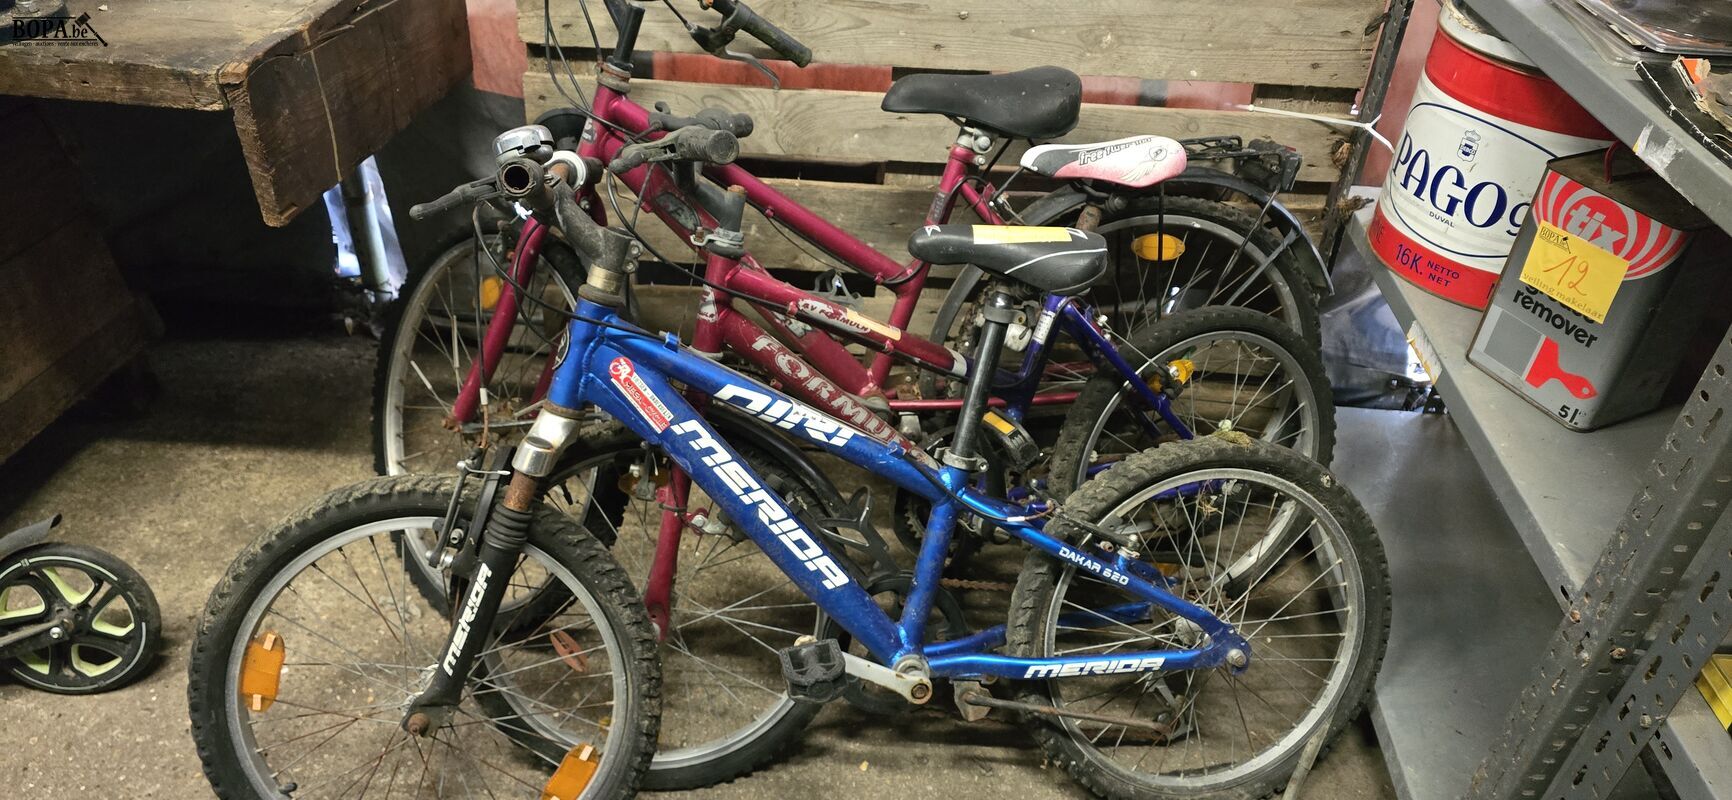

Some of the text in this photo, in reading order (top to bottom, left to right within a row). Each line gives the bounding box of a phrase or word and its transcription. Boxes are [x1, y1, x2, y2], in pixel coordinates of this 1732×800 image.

[1078, 148, 1104, 166] free
[1429, 211, 1456, 228] DUVAL
[1565, 203, 1626, 254] tix
[1427, 260, 1460, 279] NETTO
[1428, 273, 1451, 287] NET
[1543, 255, 1587, 296] 12
[1513, 289, 1598, 348] remover
[752, 335, 922, 458] FORMU
[670, 419, 850, 590] MERIDA
[1058, 546, 1130, 586] DAKAR 620
[443, 562, 493, 676] MERIDA
[1023, 657, 1166, 679] MERIDA
